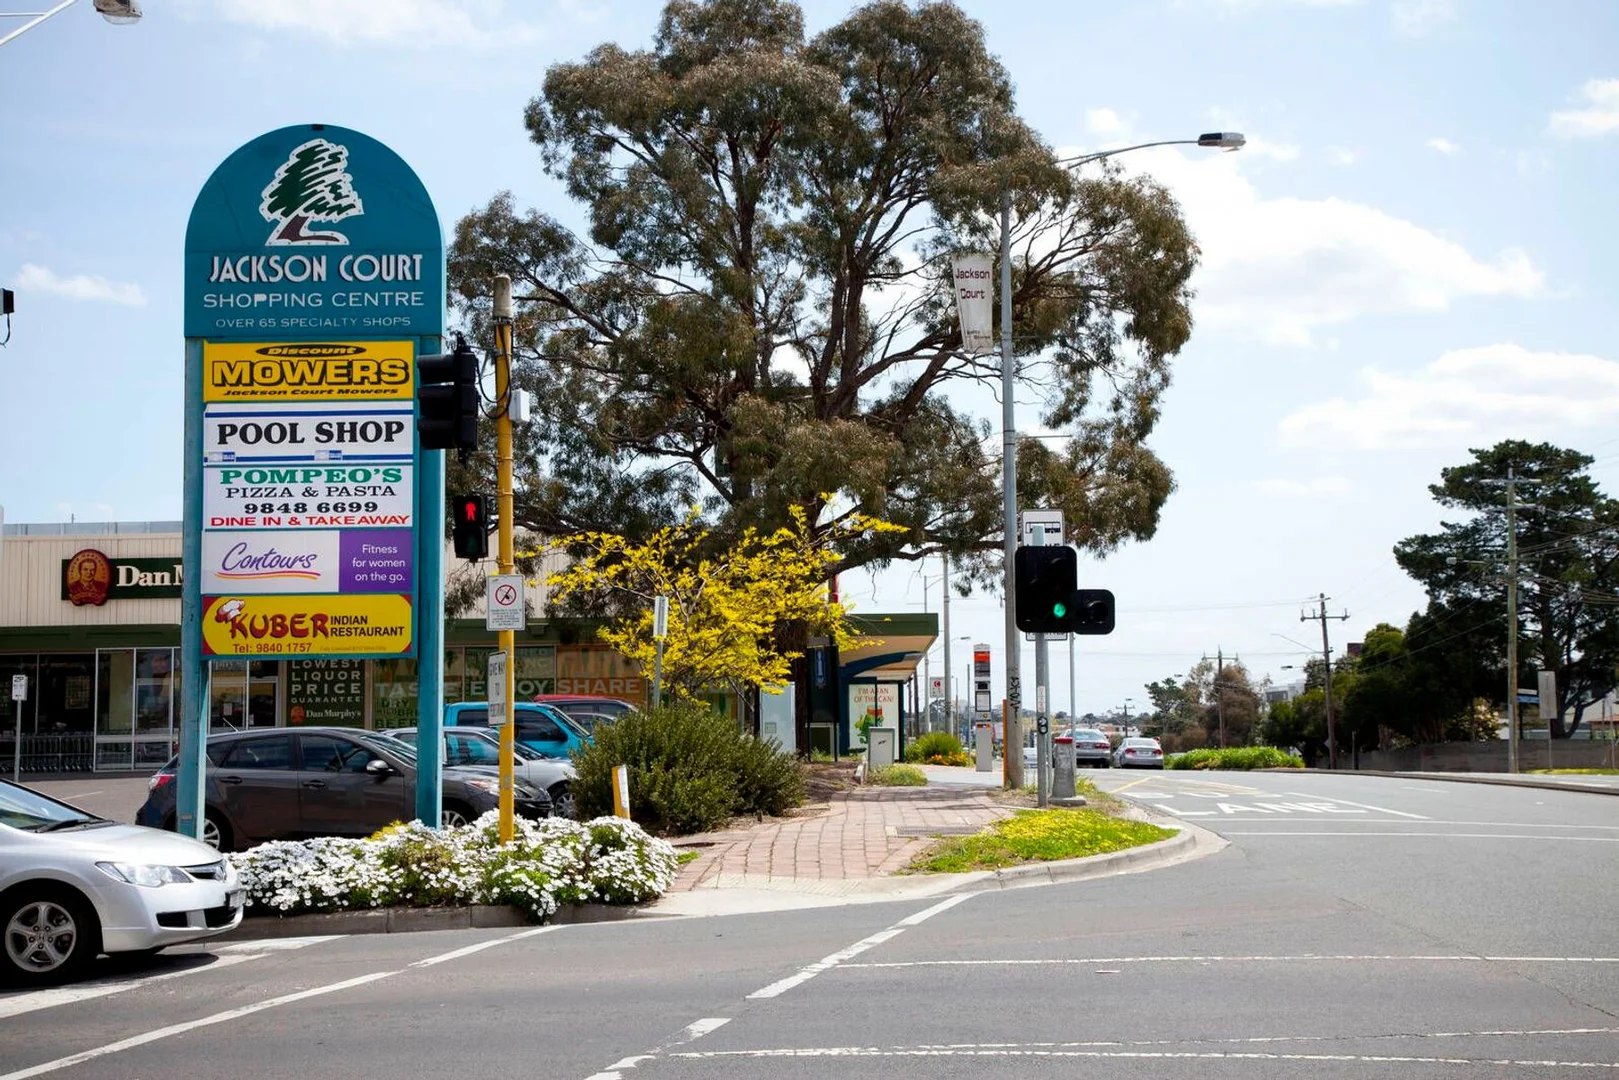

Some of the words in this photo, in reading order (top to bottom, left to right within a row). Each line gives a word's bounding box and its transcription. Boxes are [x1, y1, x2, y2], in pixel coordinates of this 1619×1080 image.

[208, 254, 327, 283] JACKSON
[338, 253, 424, 283] COURT
[955, 268, 991, 279] Jackson
[203, 292, 323, 308] SHOPPING
[331, 291, 425, 307] CENTRE
[960, 288, 986, 299] Court
[215, 318, 255, 328] OVER
[259, 318, 277, 328] 65
[280, 317, 358, 328] SPECIALTY
[362, 316, 411, 327] SHOPS
[267, 346, 357, 355] Discount
[211, 358, 410, 387] MOWERS
[290, 388, 334, 396] Court
[217, 422, 305, 445] POOL
[314, 420, 405, 443] SHOP
[220, 467, 403, 485] POMPEO'S
[225, 487, 295, 498] PIZZA
[301, 486, 319, 498] &
[325, 485, 397, 497] PASTA
[244, 502, 308, 514] 9848
[316, 501, 379, 513] 6699
[210, 516, 257, 527] DINE
[262, 516, 282, 527] IN
[287, 516, 301, 526] &
[305, 515, 410, 526] TAKEAWAY
[362, 544, 398, 554] Fitness
[221, 541, 318, 572] Contours
[352, 557, 367, 568] for
[369, 558, 406, 568] women
[116, 565, 172, 587] Dan
[355, 573, 368, 582] on
[370, 571, 386, 582] the
[388, 573, 406, 583] go.
[229, 612, 330, 640] KUBER
[330, 615, 368, 625] INDIAN
[330, 626, 405, 637] RESTAURANT
[232, 642, 252, 654] Tel:
[255, 642, 283, 653] 9840
[286, 642, 313, 653] 1757
[291, 659, 361, 669] LOWEST
[291, 671, 361, 681] LIQUOR
[291, 683, 361, 694] PRICE
[470, 680, 548, 696] EOY
[557, 679, 640, 695] SHARE
[306, 709, 323, 718] Dan
[323, 708, 362, 720] Murphy's
[1154, 802, 1370, 816] LANE
